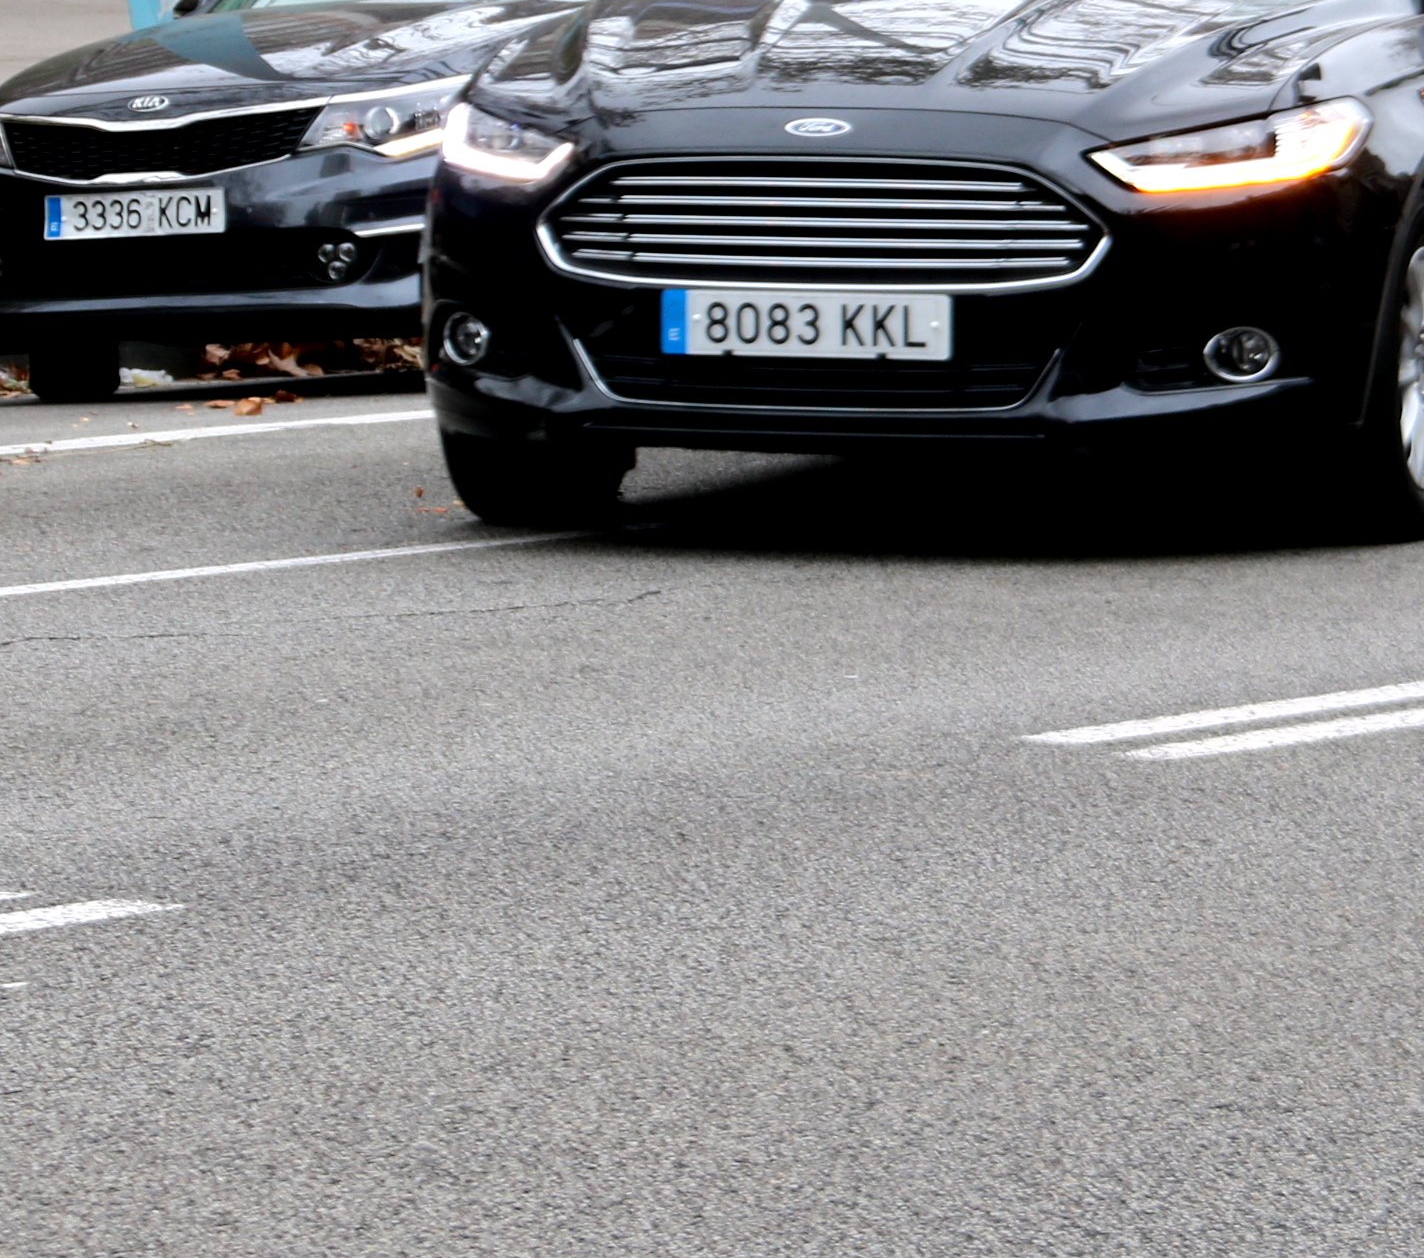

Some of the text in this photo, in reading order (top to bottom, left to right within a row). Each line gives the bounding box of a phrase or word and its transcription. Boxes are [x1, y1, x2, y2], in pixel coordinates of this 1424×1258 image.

[131, 96, 161, 109] KIA
[72, 198, 142, 232] 3336
[158, 195, 212, 228] KCM
[705, 301, 820, 346] 8083
[841, 304, 927, 348] KKL
